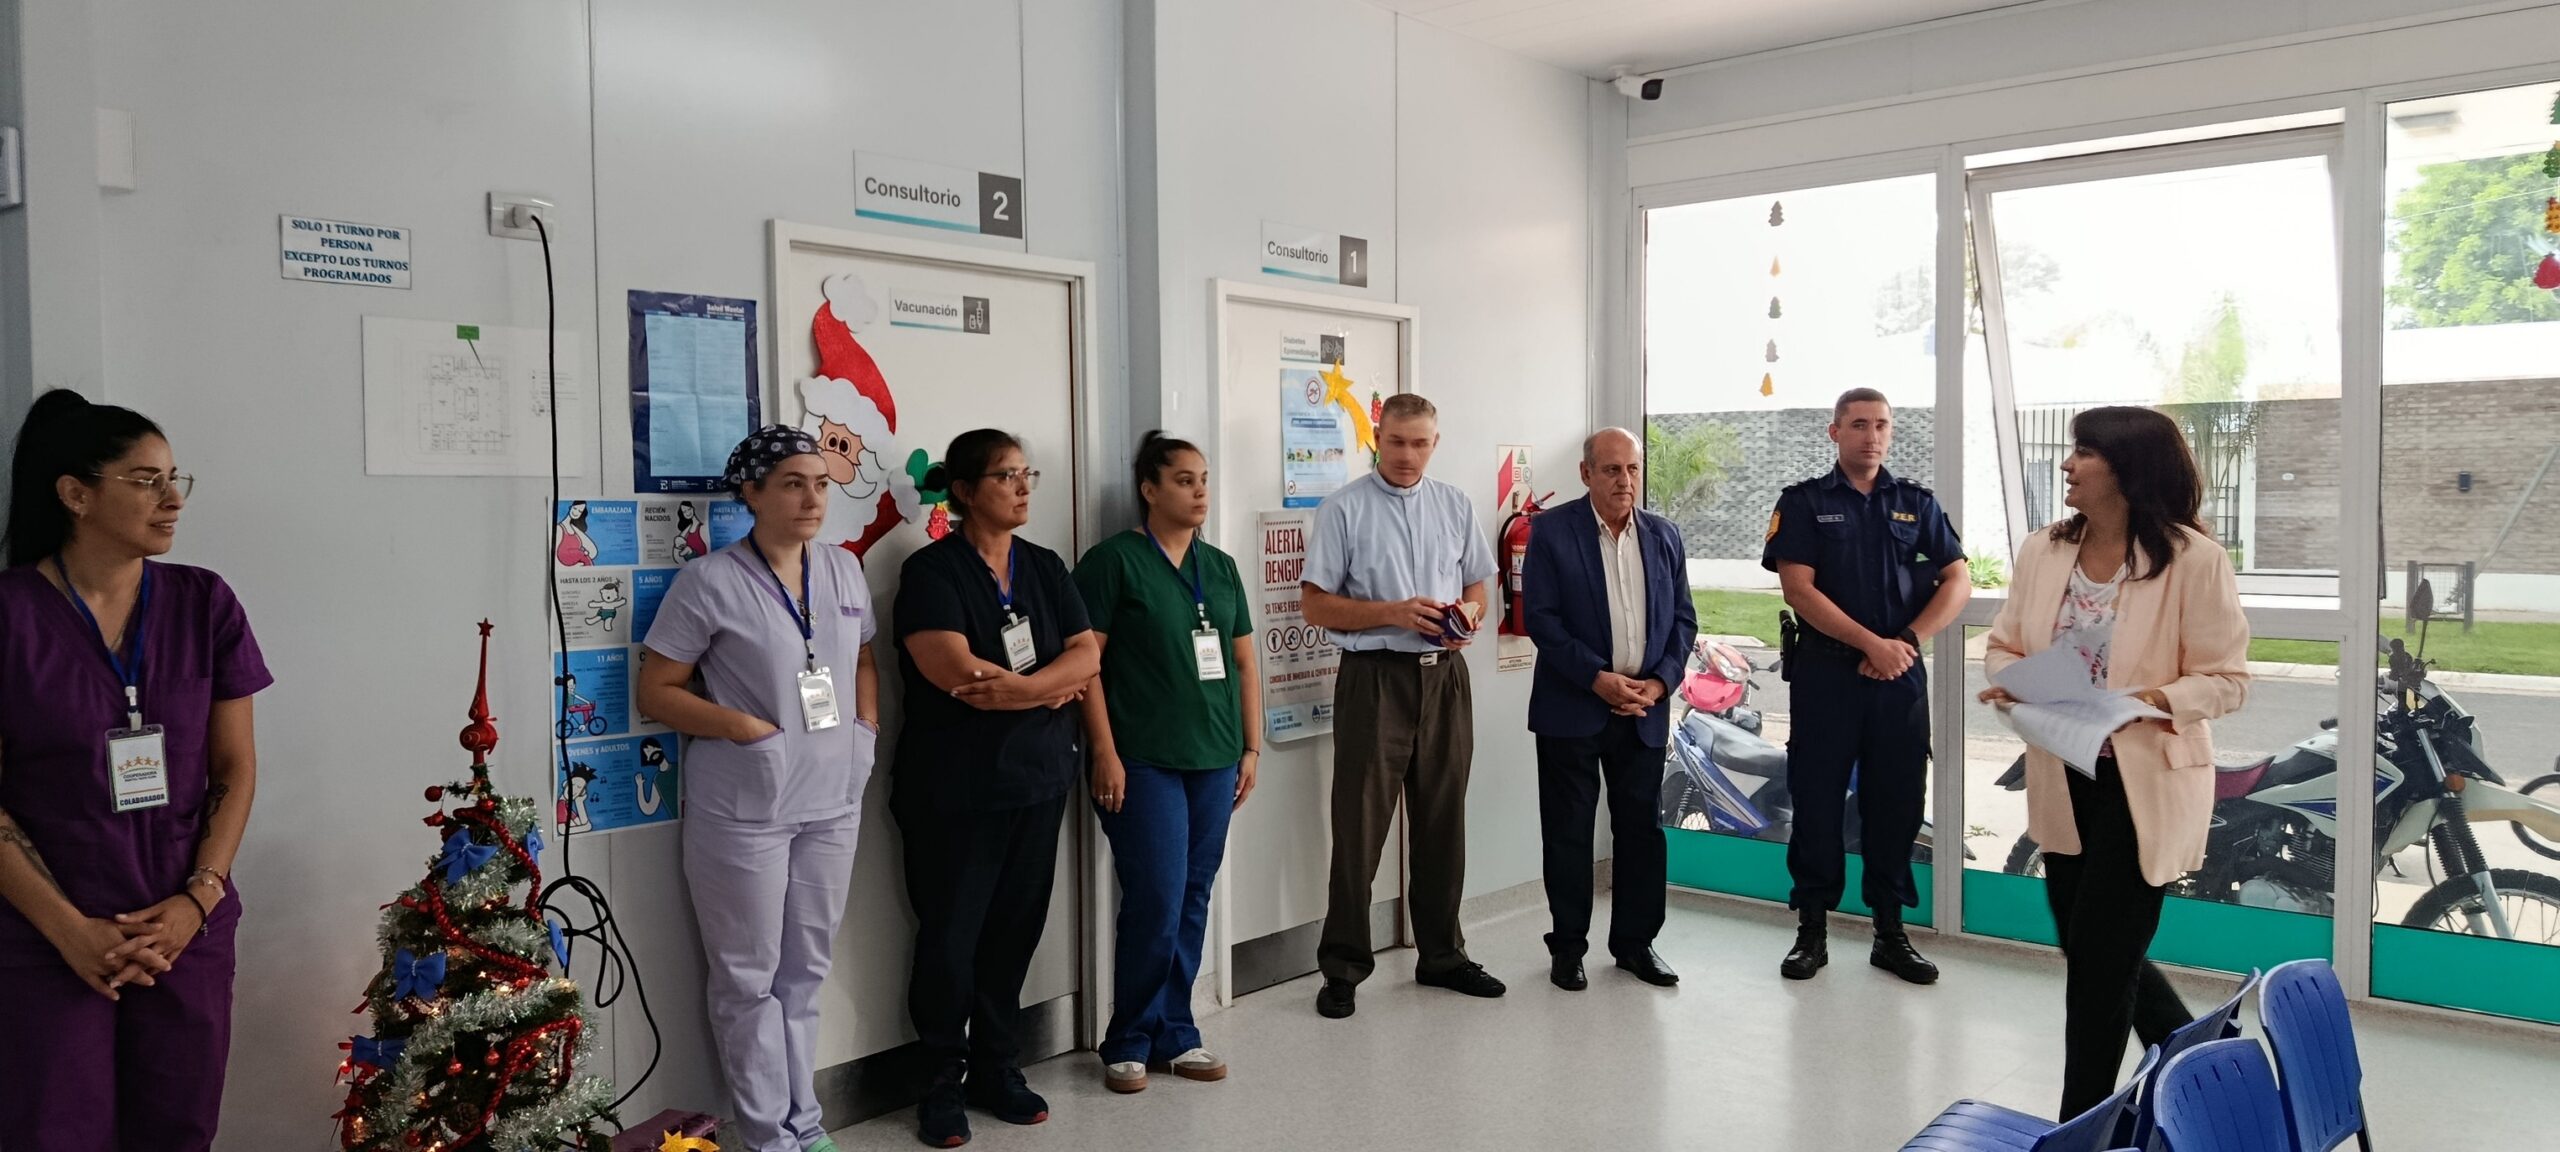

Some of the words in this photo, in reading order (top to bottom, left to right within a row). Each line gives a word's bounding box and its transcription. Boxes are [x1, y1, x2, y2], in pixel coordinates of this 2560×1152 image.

[864, 177, 961, 208] Consultorio
[992, 190, 1010, 222] 2
[291, 219, 323, 232] SOLO
[326, 223, 332, 233] 1
[335, 223, 375, 238] TURNO
[377, 228, 401, 241] POR
[320, 237, 374, 252] PERSONA
[284, 250, 337, 265] EXCEPTO
[339, 256, 361, 267] LOS
[362, 258, 409, 272] TURNOS
[1267, 240, 1329, 264] Consultorio
[1350, 250, 1357, 274] 1
[303, 267, 392, 284] PROGRAMADOS
[894, 299, 958, 317] Vacunación
[591, 506, 632, 515] EMBARAZADA
[645, 505, 667, 514] RECIÉN
[645, 514, 671, 523] NACIDOS
[1265, 528, 1305, 556] ALERTA
[560, 577, 579, 585] HASTA
[580, 576, 591, 584] LOS
[597, 574, 613, 583] AÑOS
[638, 576, 643, 584] 5
[645, 574, 663, 584] AÑOS
[1265, 603, 1271, 615] SI
[597, 655, 605, 663] 11
[606, 652, 624, 663] AÑOS
[600, 743, 630, 754] ADULTOS
